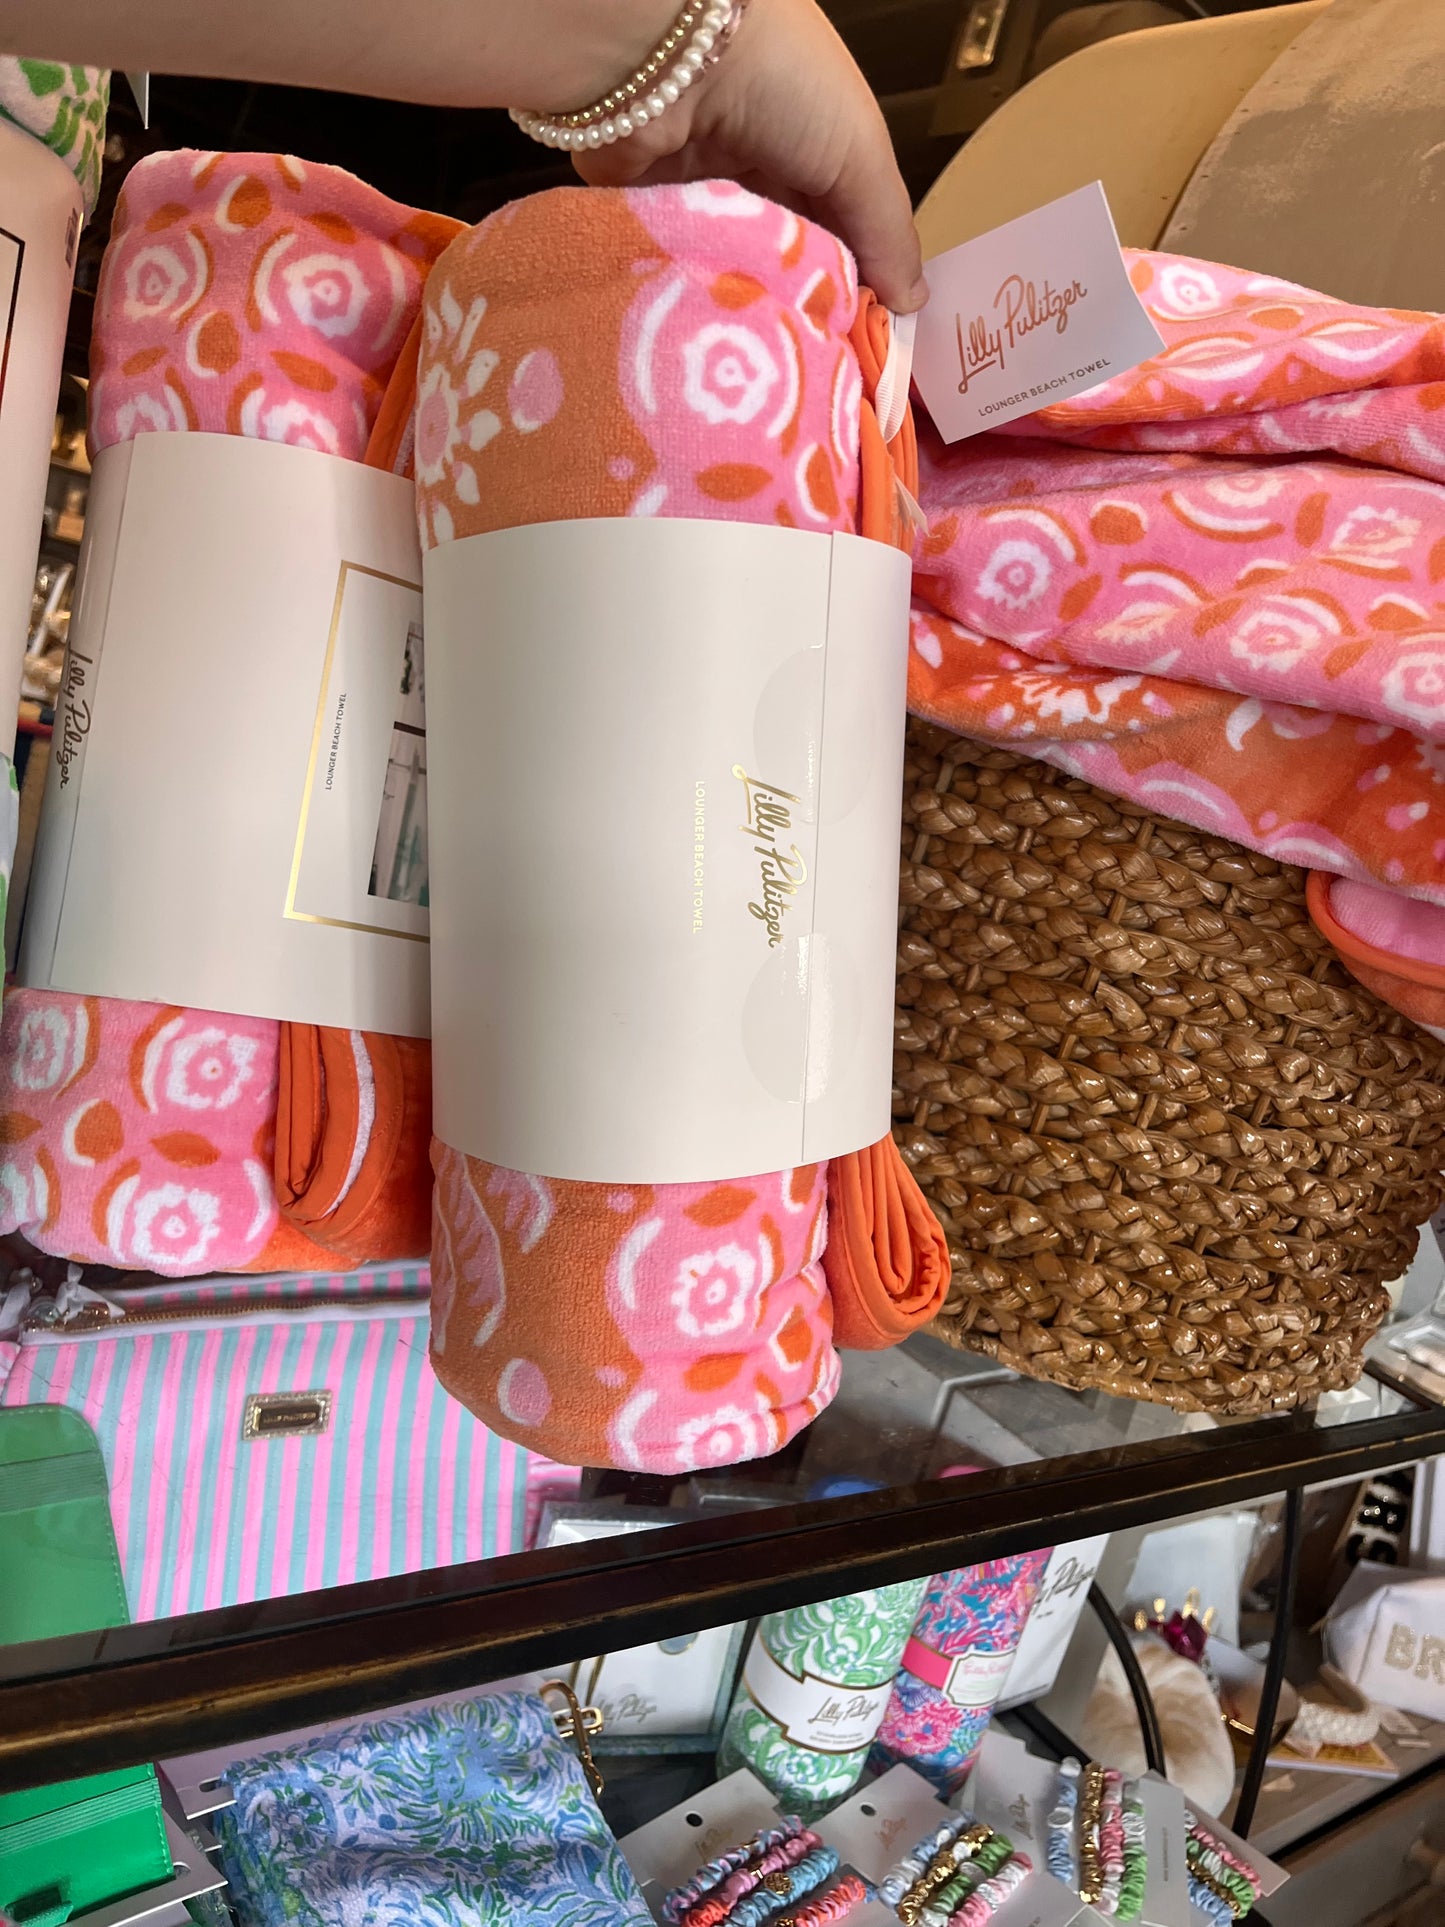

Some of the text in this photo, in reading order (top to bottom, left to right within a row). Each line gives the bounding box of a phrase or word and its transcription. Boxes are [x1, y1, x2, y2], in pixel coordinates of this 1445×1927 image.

[957, 274, 1088, 394] Lilly Pulitzer
[978, 358, 1111, 417] LOUNGER BEACH TOWEL
[56, 641, 93, 790] Lilly Pulitzer
[325, 693, 347, 790] LOUNGER BEACH TOWEL
[692, 781, 706, 934] LOUNGER BEACH TOWEL
[731, 763, 808, 949] Lilly Pulitzer
